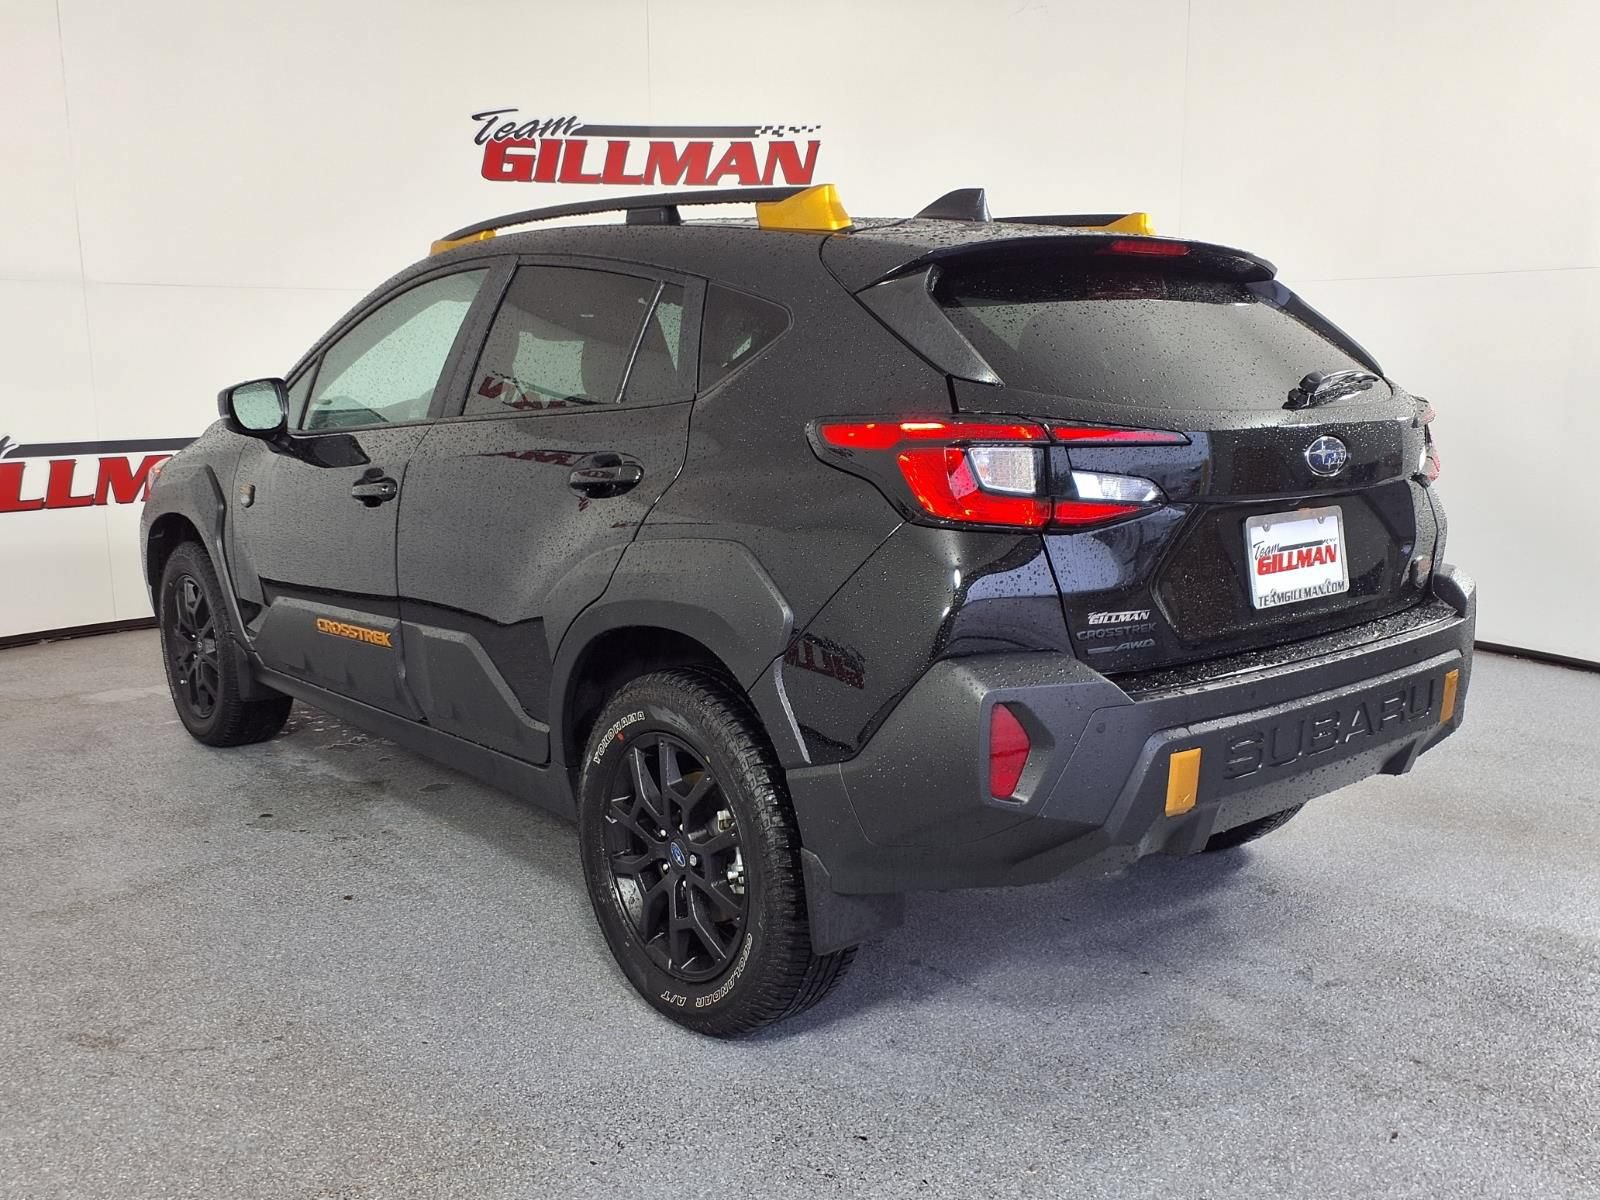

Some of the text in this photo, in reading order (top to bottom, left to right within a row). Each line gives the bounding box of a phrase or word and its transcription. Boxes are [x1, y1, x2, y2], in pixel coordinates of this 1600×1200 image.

[471, 108, 581, 145] Team
[481, 138, 821, 186] GILLMAN
[1253, 540, 1281, 560] Team
[1257, 543, 1337, 576] GILLMAN
[1258, 581, 1345, 607] TEAMGILLMAN.COM
[317, 618, 392, 648] CROSSTREK
[1076, 622, 1157, 641] CROSSTREK
[1089, 611, 1149, 625] GILLMAN
[1114, 638, 1156, 652] AWD
[593, 711, 646, 765] YOKOHAMA
[1223, 678, 1436, 780] SUBARU
[660, 932, 753, 1008] GEOLANDAR A/T
